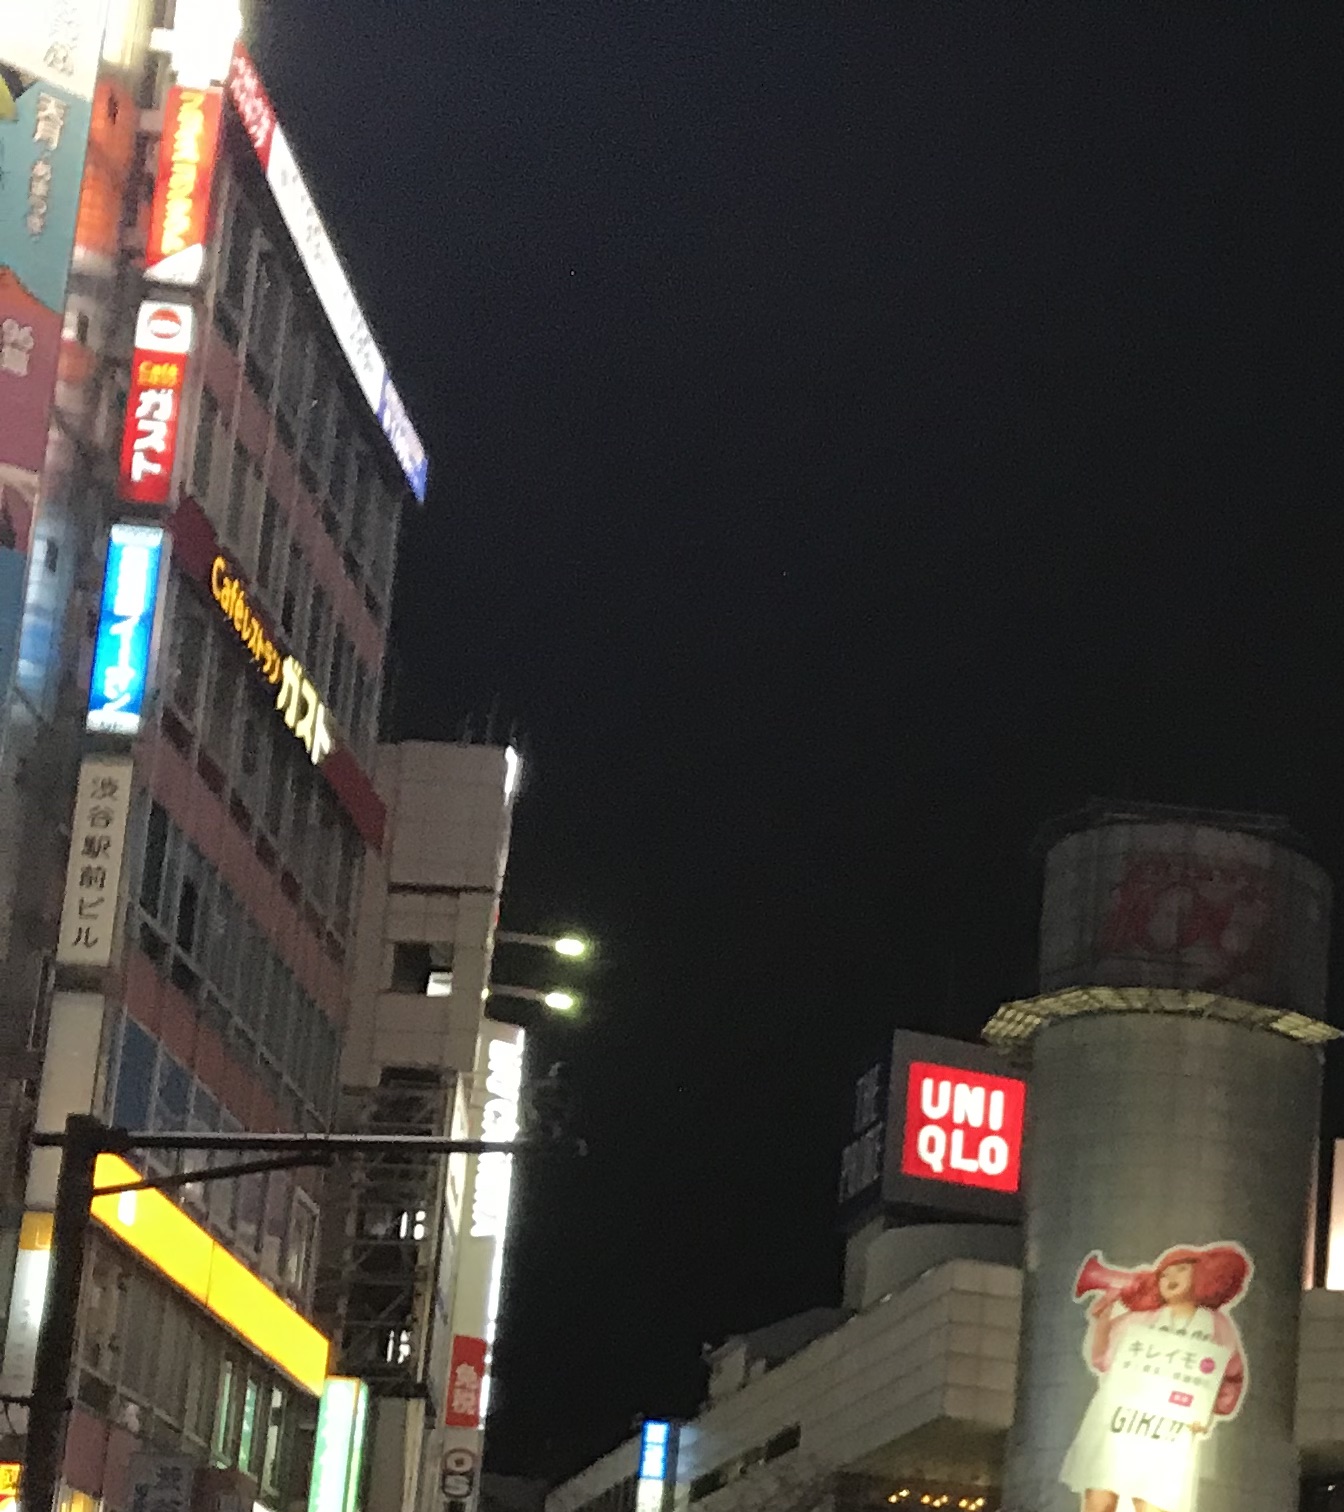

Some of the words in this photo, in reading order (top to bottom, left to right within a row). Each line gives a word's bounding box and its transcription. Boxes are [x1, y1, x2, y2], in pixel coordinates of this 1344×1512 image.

[131, 389, 174, 484] ガスト
[276, 655, 333, 767] ガスト
[71, 775, 120, 950] 渋谷駅前ビル
[921, 1078, 1004, 1128] UNI
[917, 1126, 1010, 1177] QLO
[1129, 1340, 1198, 1370] キレイモ
